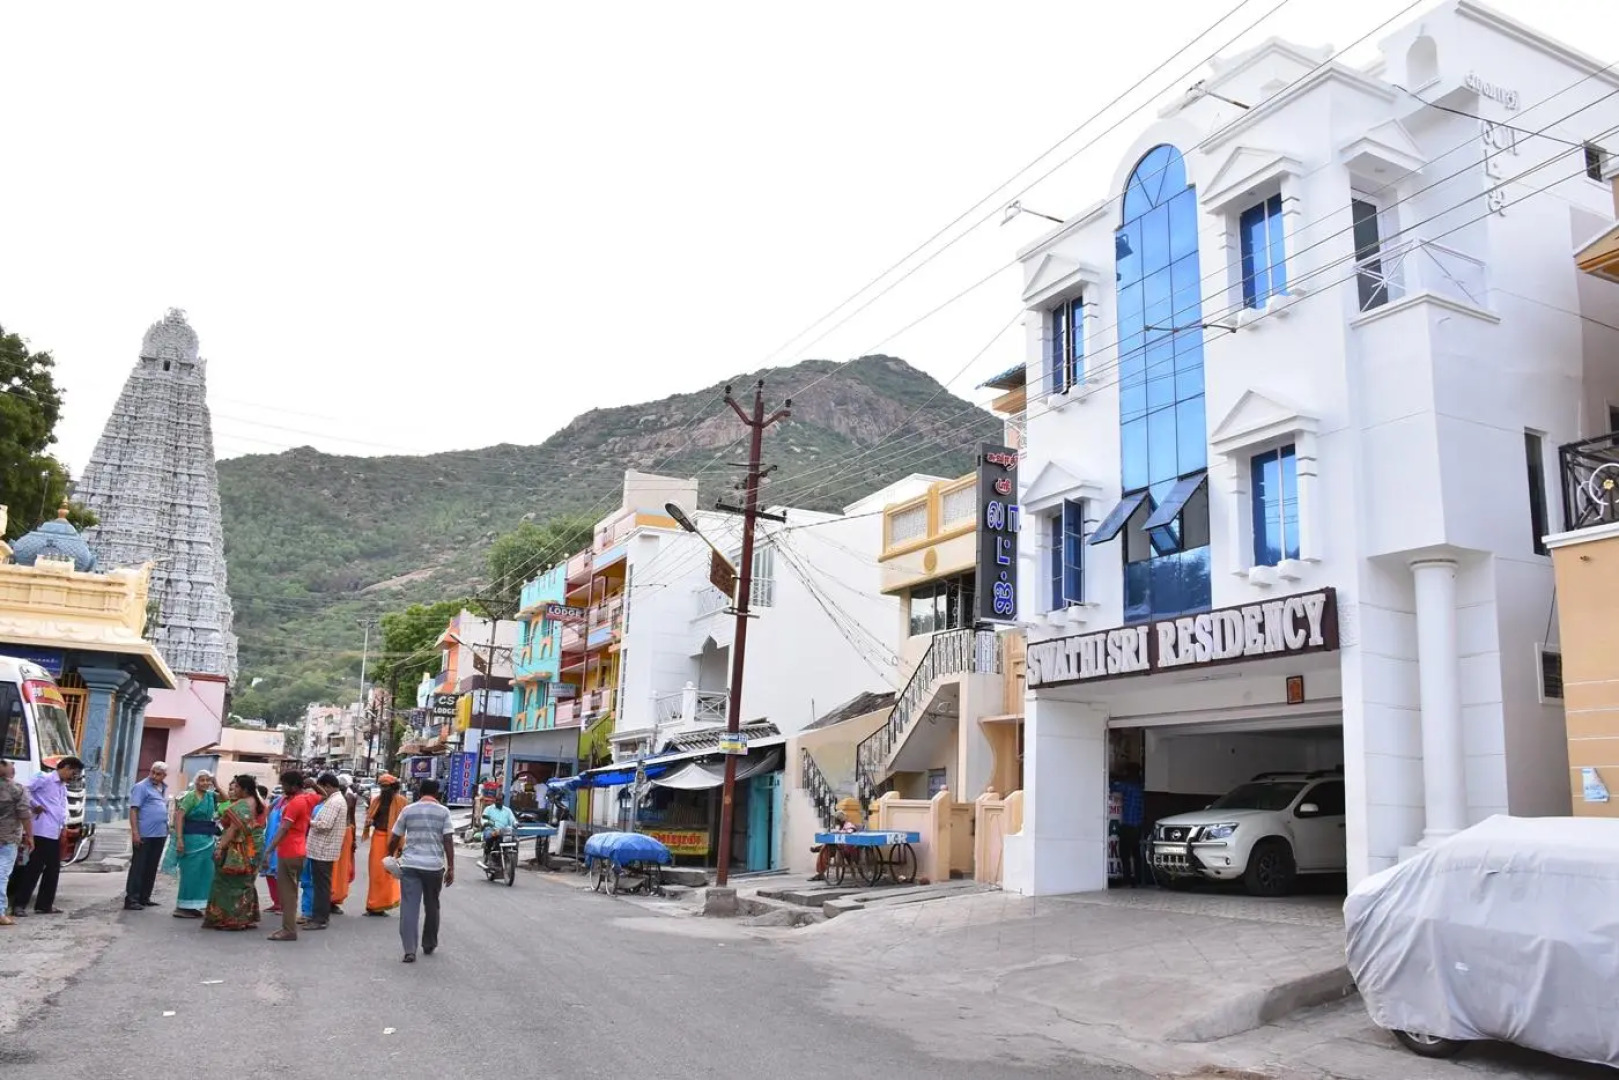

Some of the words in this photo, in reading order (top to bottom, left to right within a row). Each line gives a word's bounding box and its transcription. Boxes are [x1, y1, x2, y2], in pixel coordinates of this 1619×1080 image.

[548, 605, 581, 618] LODGE
[1157, 592, 1326, 668] RESIDENCY
[438, 695, 456, 705] CS
[433, 707, 456, 715] LODGE
